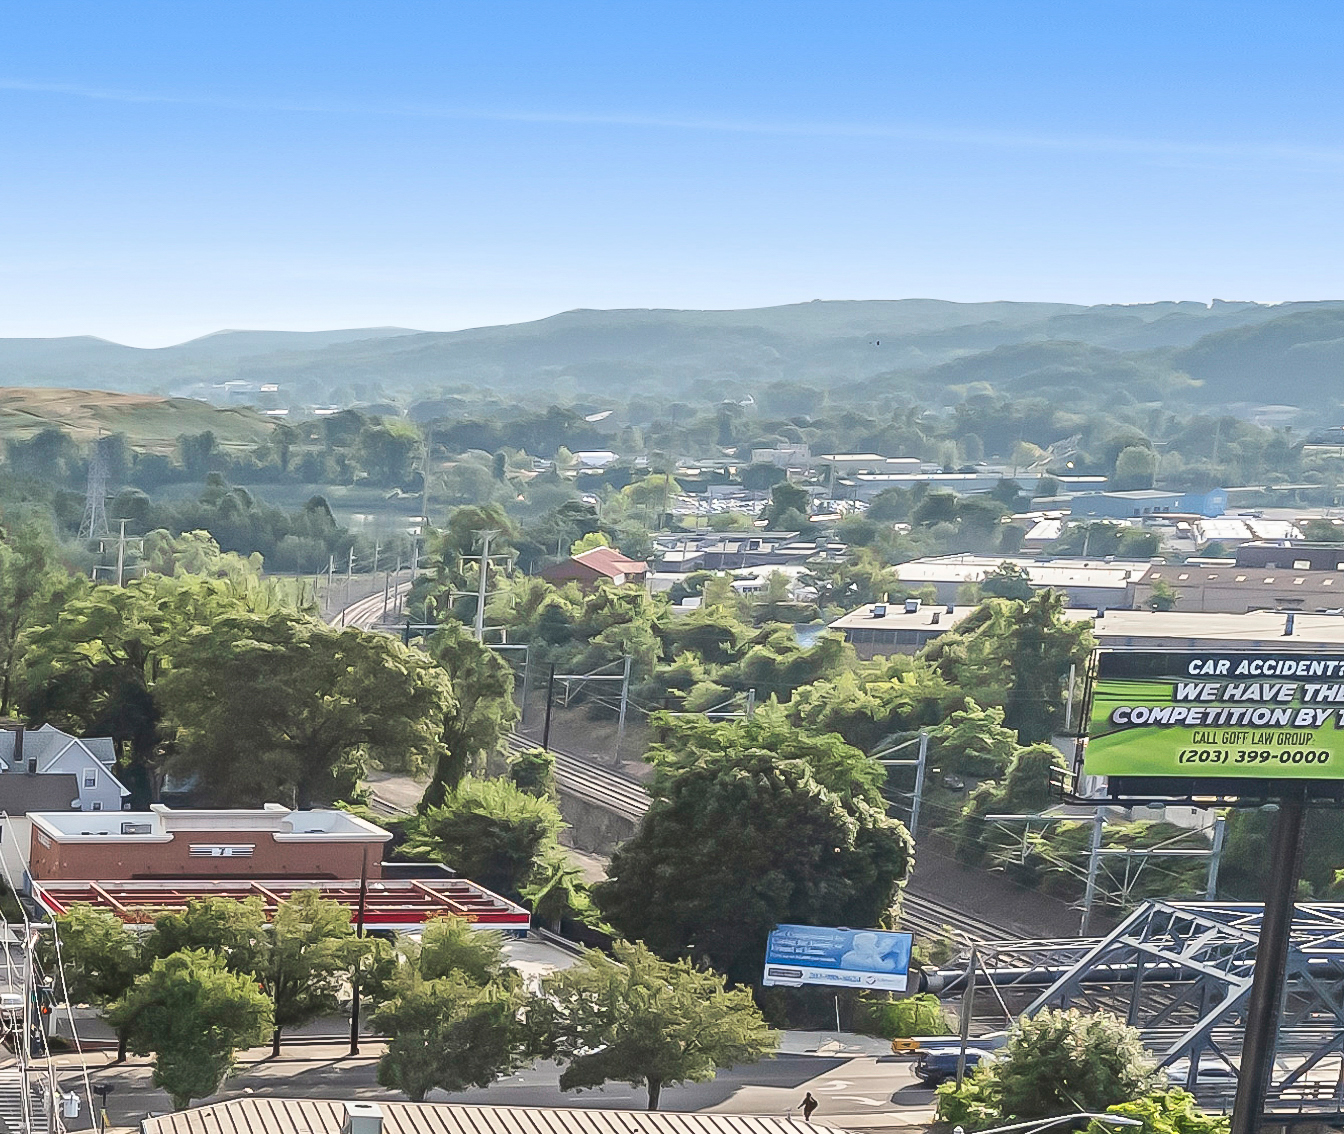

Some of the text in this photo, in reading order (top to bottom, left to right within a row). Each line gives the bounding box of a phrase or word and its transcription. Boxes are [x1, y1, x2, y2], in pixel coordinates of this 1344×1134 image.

[1188, 660, 1344, 676] CAR ACCIDENT?
[1176, 683, 1220, 701] WE
[1223, 683, 1298, 701] HAVE
[1113, 706, 1292, 725] COMPETITION
[1294, 708, 1335, 726] BY
[1192, 731, 1218, 745] CALL
[1222, 732, 1249, 745] GOFF
[1252, 733, 1275, 745] LAW
[1178, 750, 1330, 764] (203) 399-0000
